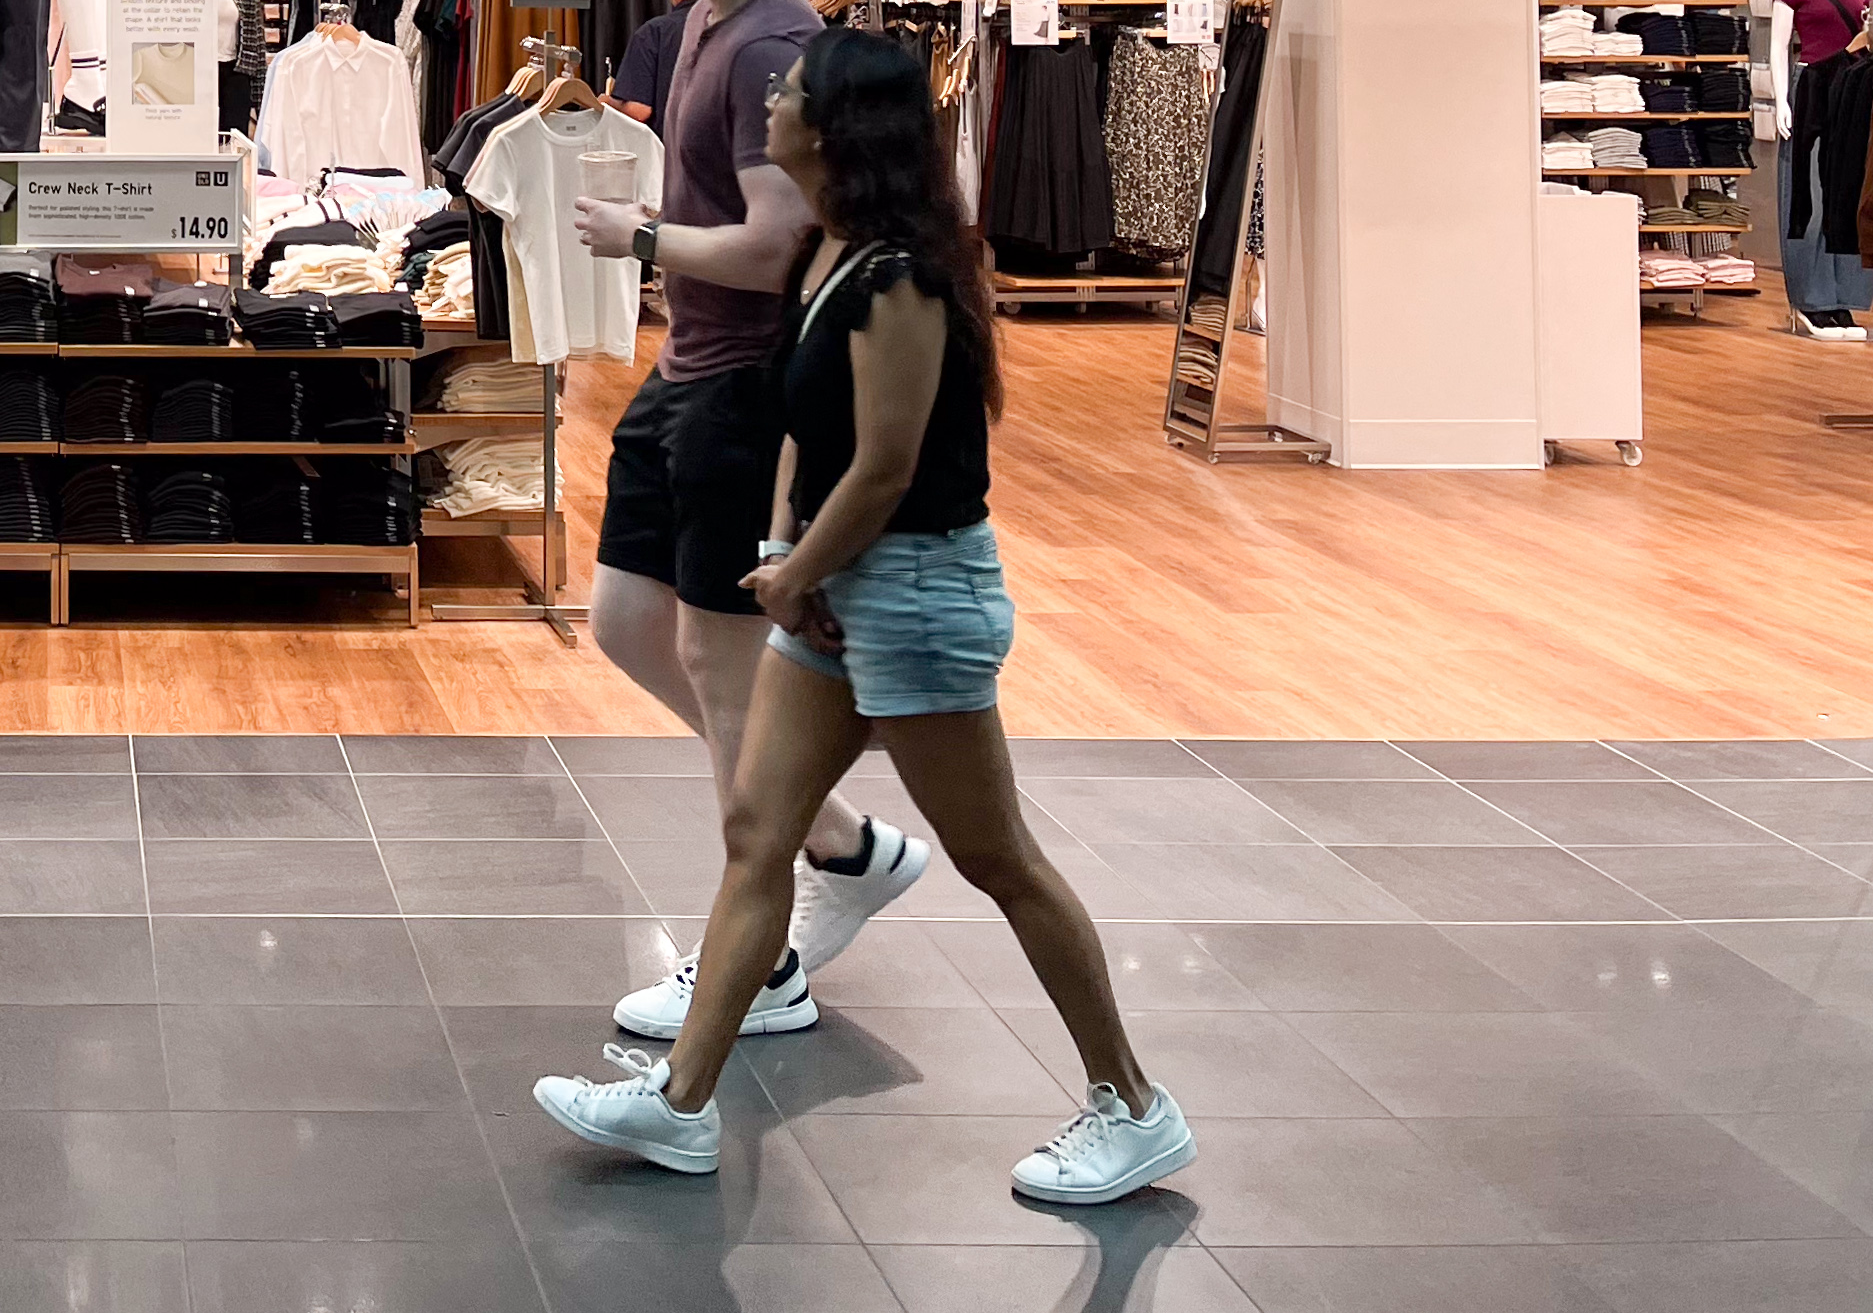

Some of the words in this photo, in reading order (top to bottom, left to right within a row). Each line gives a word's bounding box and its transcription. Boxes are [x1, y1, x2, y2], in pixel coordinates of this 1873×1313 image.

[216, 173, 225, 185] U
[28, 182, 61, 195] Crew
[67, 182, 99, 195] Neck
[105, 182, 152, 195] T-Shirt
